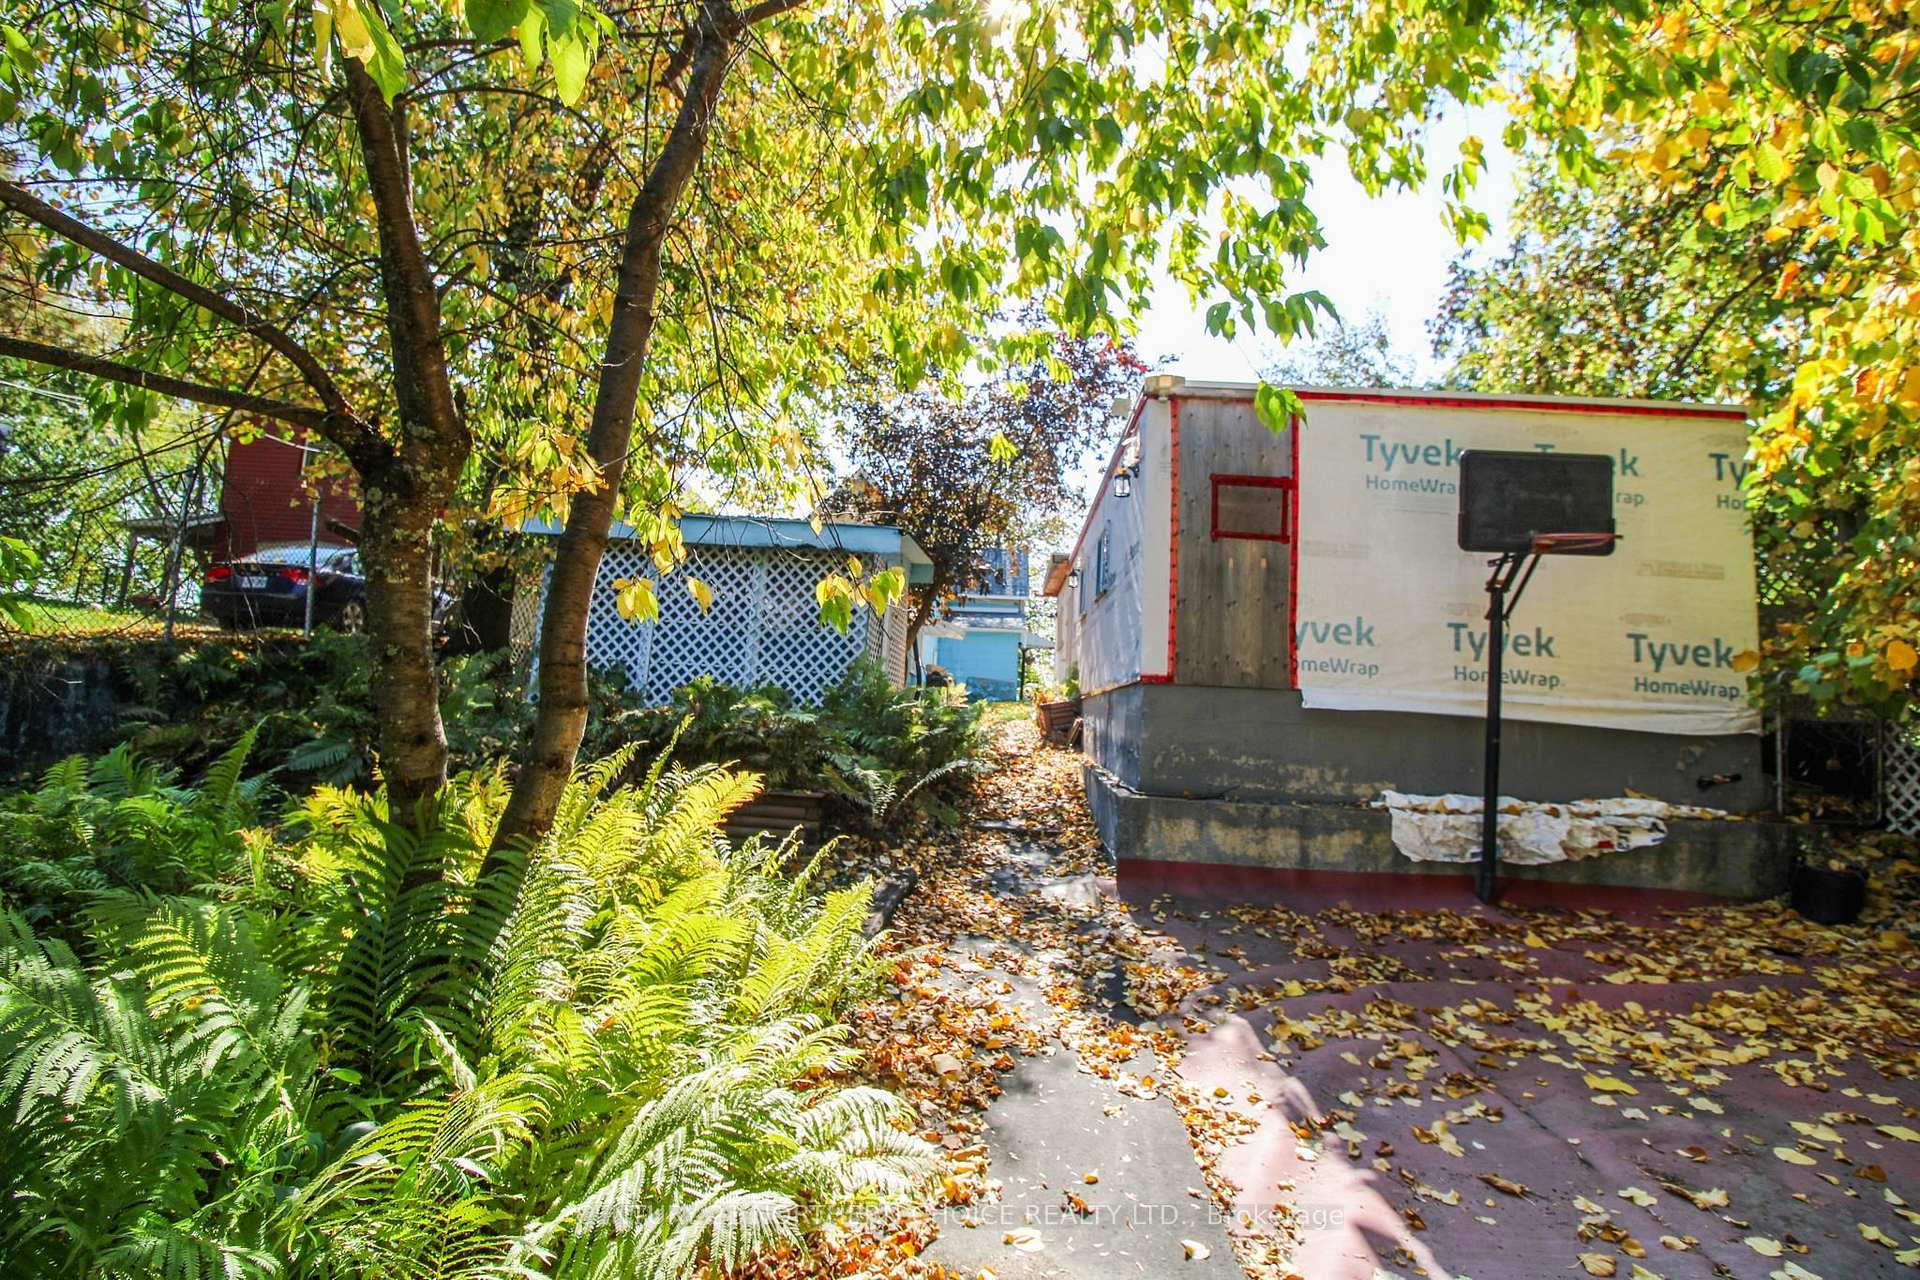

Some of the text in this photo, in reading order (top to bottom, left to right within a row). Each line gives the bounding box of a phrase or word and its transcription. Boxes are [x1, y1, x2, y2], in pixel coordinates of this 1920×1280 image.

[1359, 434, 1462, 471] Tyvek
[1365, 475, 1457, 495] HomeWra
[1296, 615, 1376, 650] yvek
[1300, 657, 1380, 679] meWrap
[1626, 633, 1733, 673] Tyvek
[1634, 676, 1741, 701] HomeWrap
